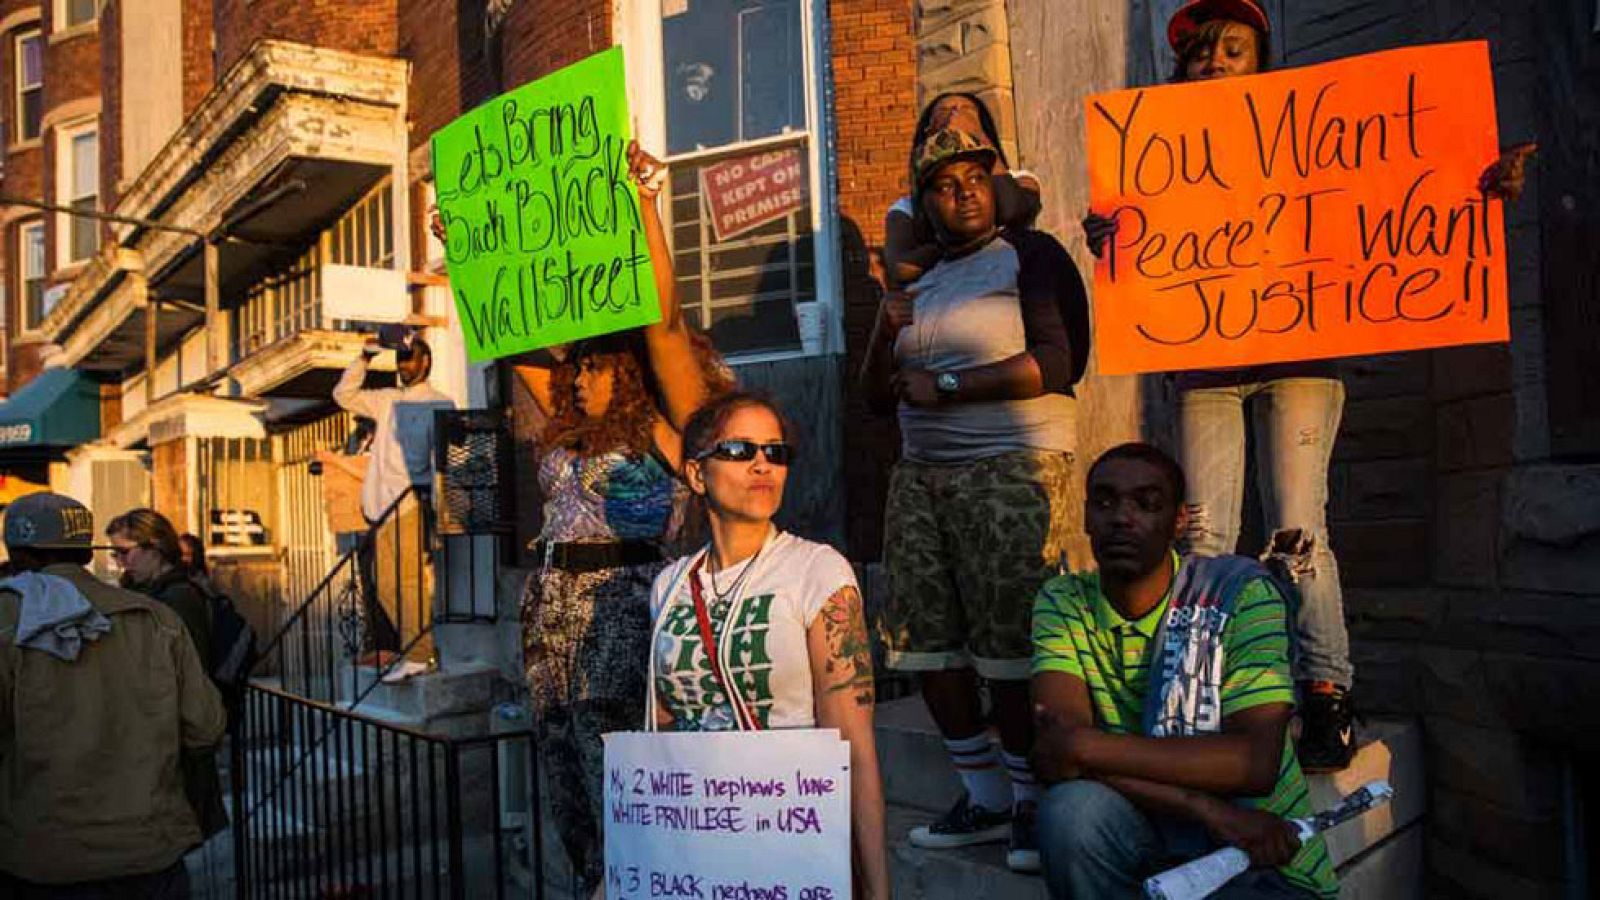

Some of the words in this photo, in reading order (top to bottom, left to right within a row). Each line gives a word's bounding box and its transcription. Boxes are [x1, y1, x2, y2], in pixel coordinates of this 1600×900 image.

[1094, 91, 1230, 197] You
[1245, 73, 1437, 178] Want
[716, 165, 743, 186] NO
[722, 177, 767, 207] KEPT
[772, 163, 800, 184] ON
[1108, 194, 1286, 282] Peace?
[1279, 188, 1345, 268] I
[632, 769, 645, 795] 2
[650, 772, 693, 798] WHITE
[796, 768, 835, 797] have
[612, 803, 650, 826] WHITE
[655, 806, 744, 833] PRIVILEGE
[756, 813, 771, 832] in
[778, 806, 822, 834] USA
[627, 866, 640, 892] 3
[650, 871, 704, 898] BLACK
